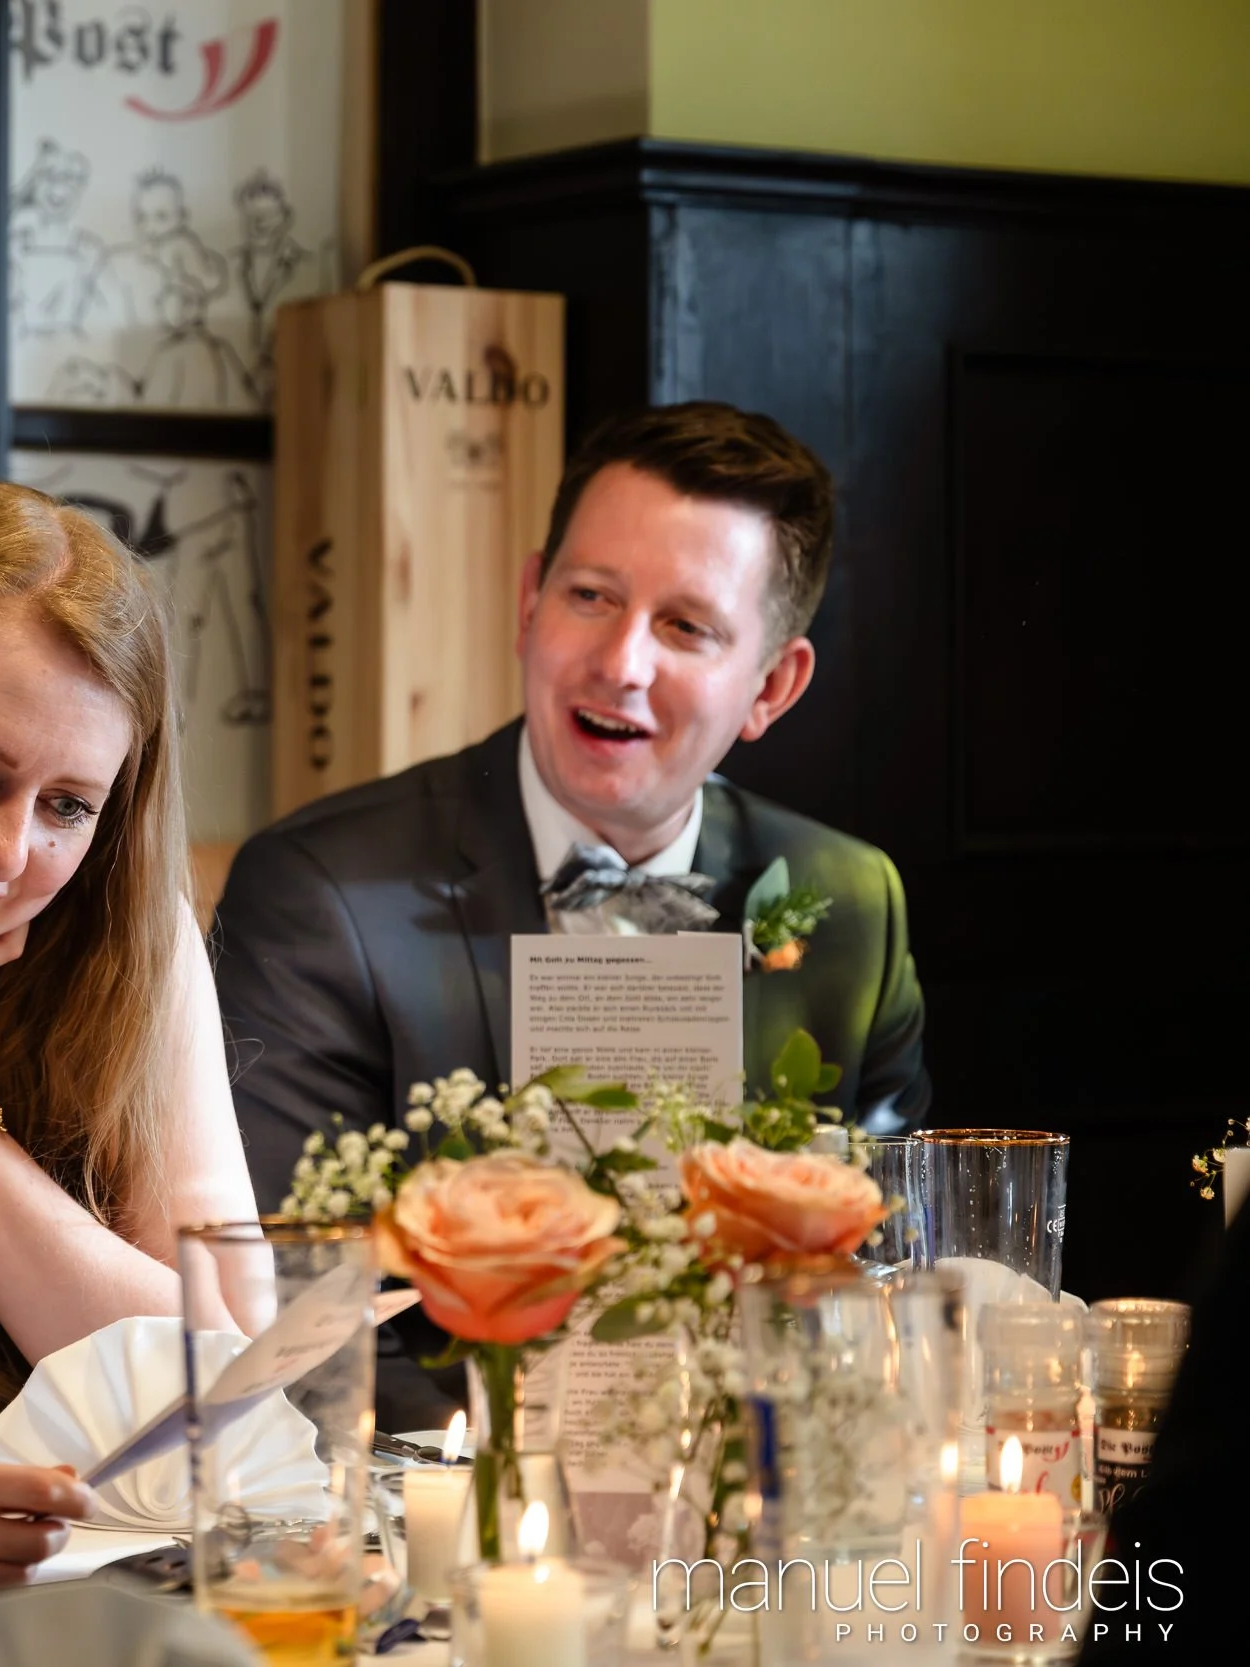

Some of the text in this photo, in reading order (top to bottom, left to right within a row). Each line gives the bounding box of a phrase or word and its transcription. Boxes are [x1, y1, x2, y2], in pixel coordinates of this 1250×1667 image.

[10, 0, 180, 80] Post
[403, 365, 550, 409] VALDO
[307, 536, 334, 773] VALDO
